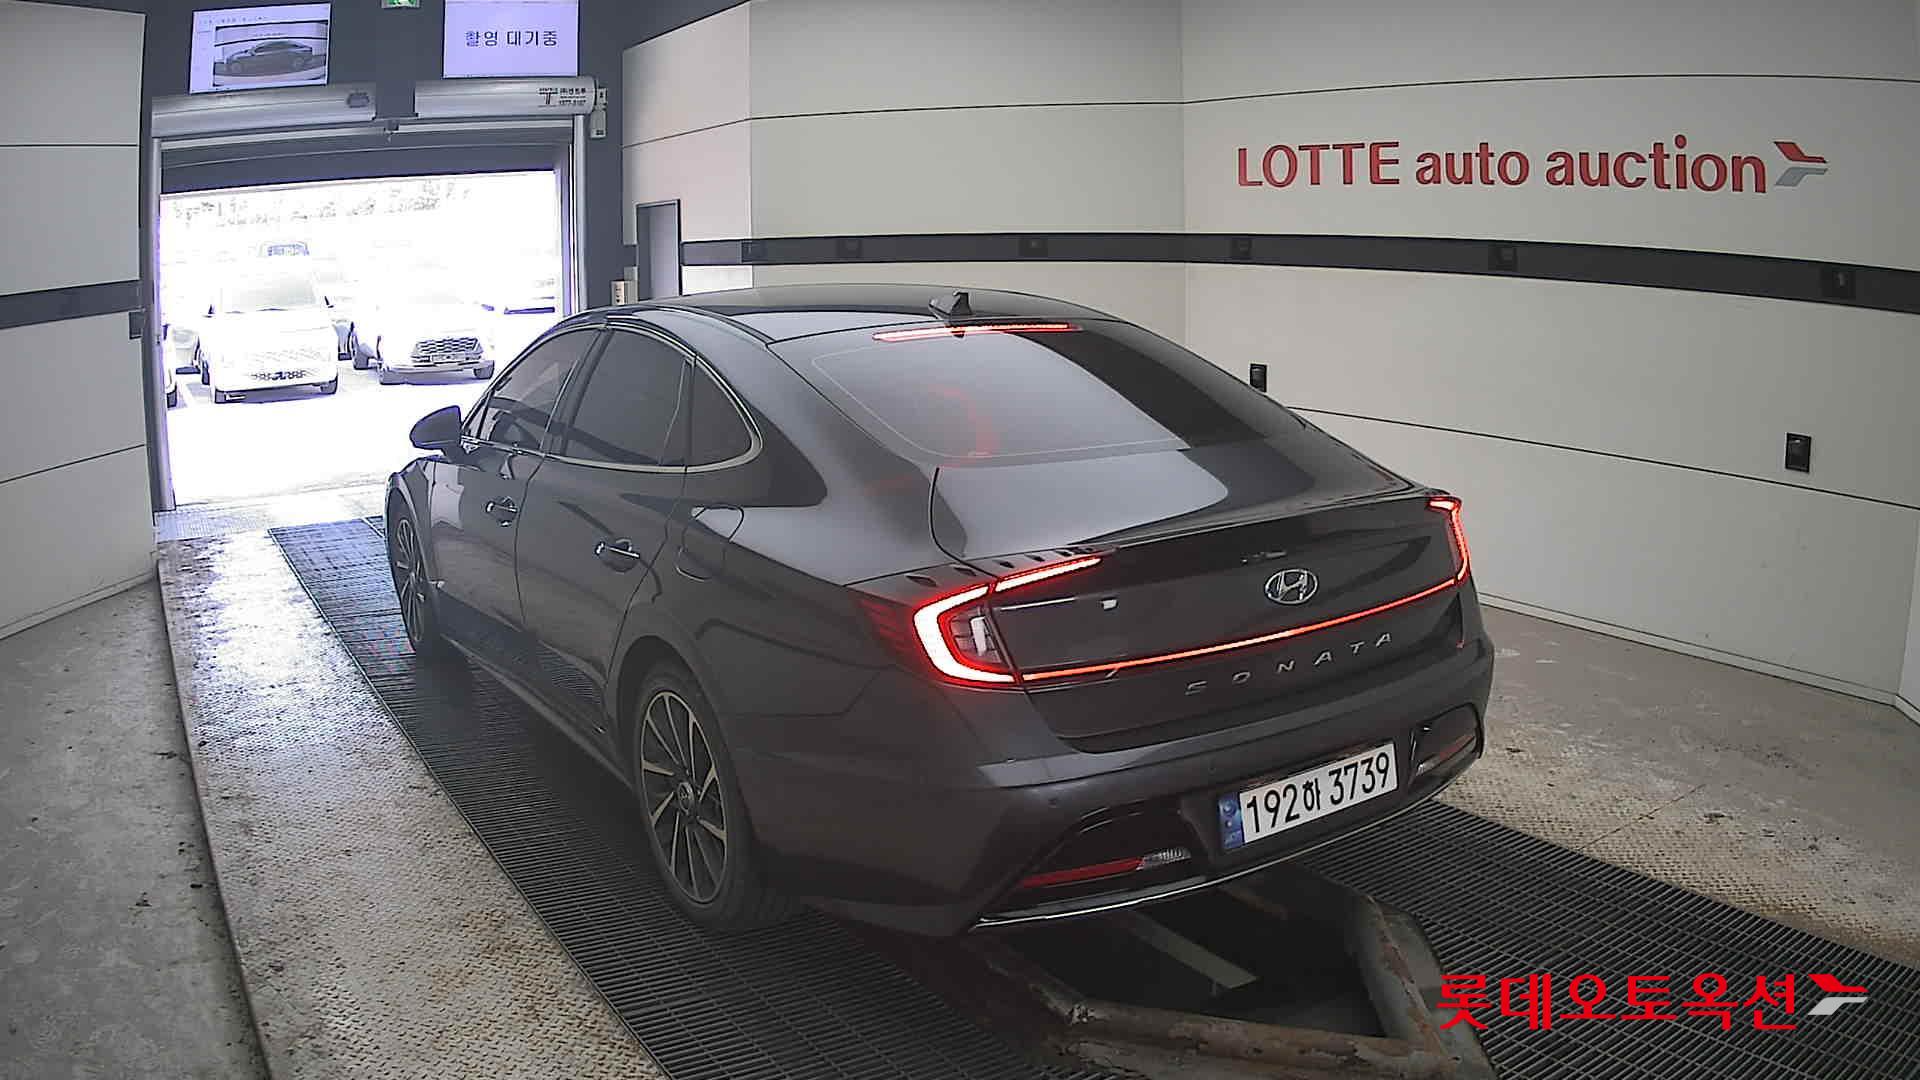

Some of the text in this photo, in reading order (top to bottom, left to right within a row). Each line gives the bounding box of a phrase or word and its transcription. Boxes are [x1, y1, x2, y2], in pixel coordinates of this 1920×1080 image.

[506, 30, 557, 47] 대기중
[1238, 134, 1767, 194] LOTTE auto auction
[1185, 632, 1392, 696] SONATA
[1246, 752, 1390, 833] 192하 3739
